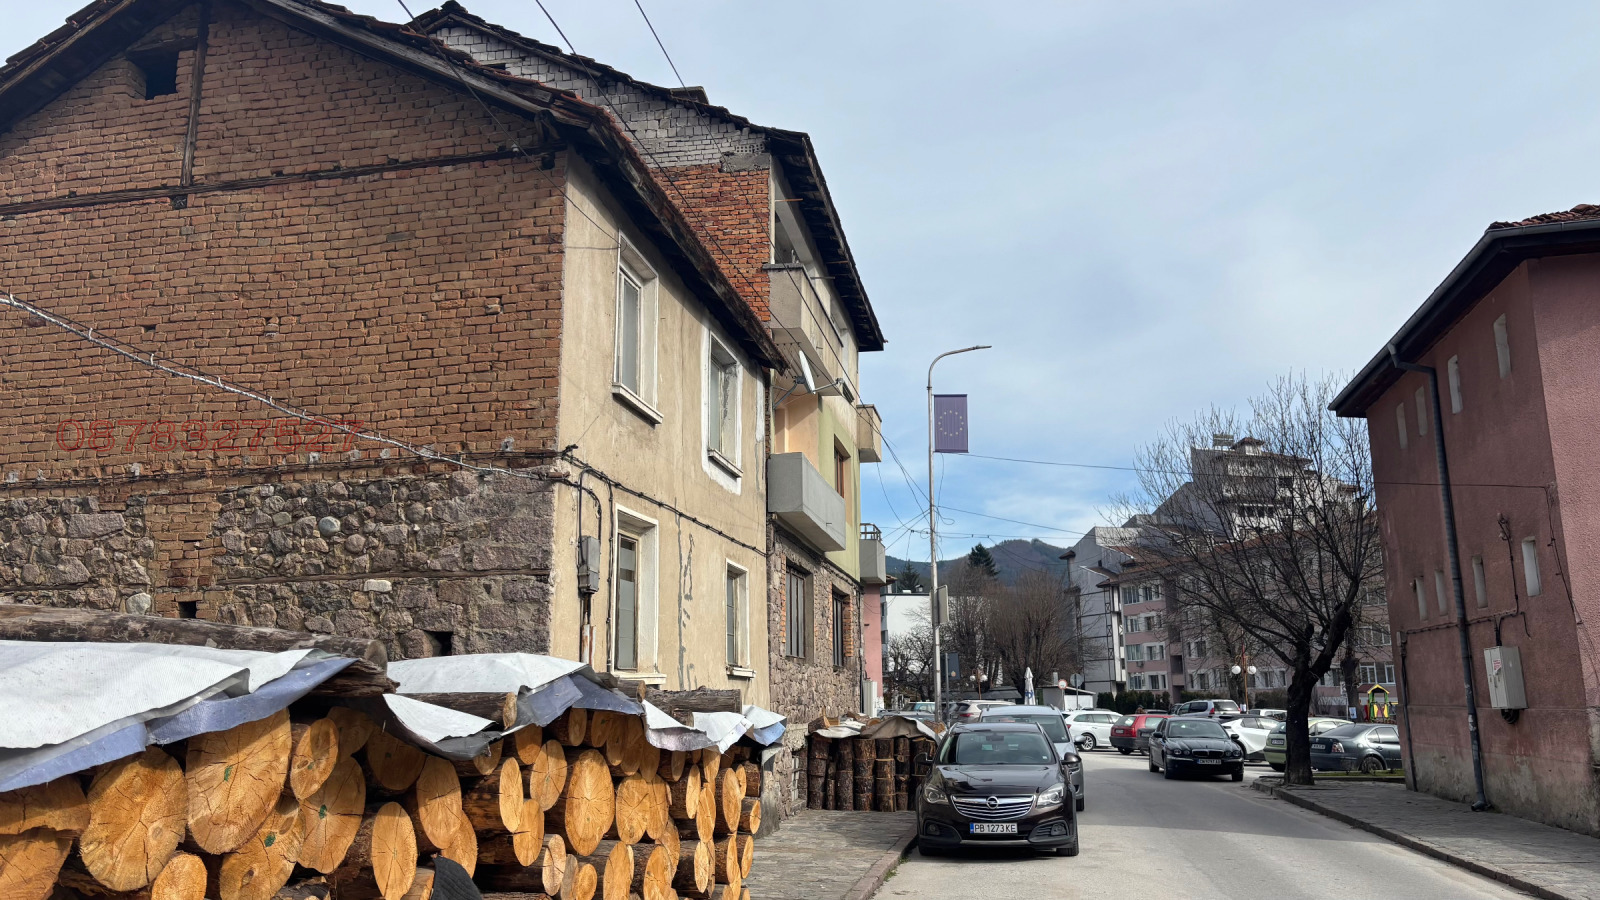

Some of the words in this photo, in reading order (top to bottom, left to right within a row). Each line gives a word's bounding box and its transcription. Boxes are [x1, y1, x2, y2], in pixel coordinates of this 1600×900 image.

[974, 824, 985, 832] PB
[987, 824, 1005, 832] 1273
[1005, 824, 1016, 832] KE
